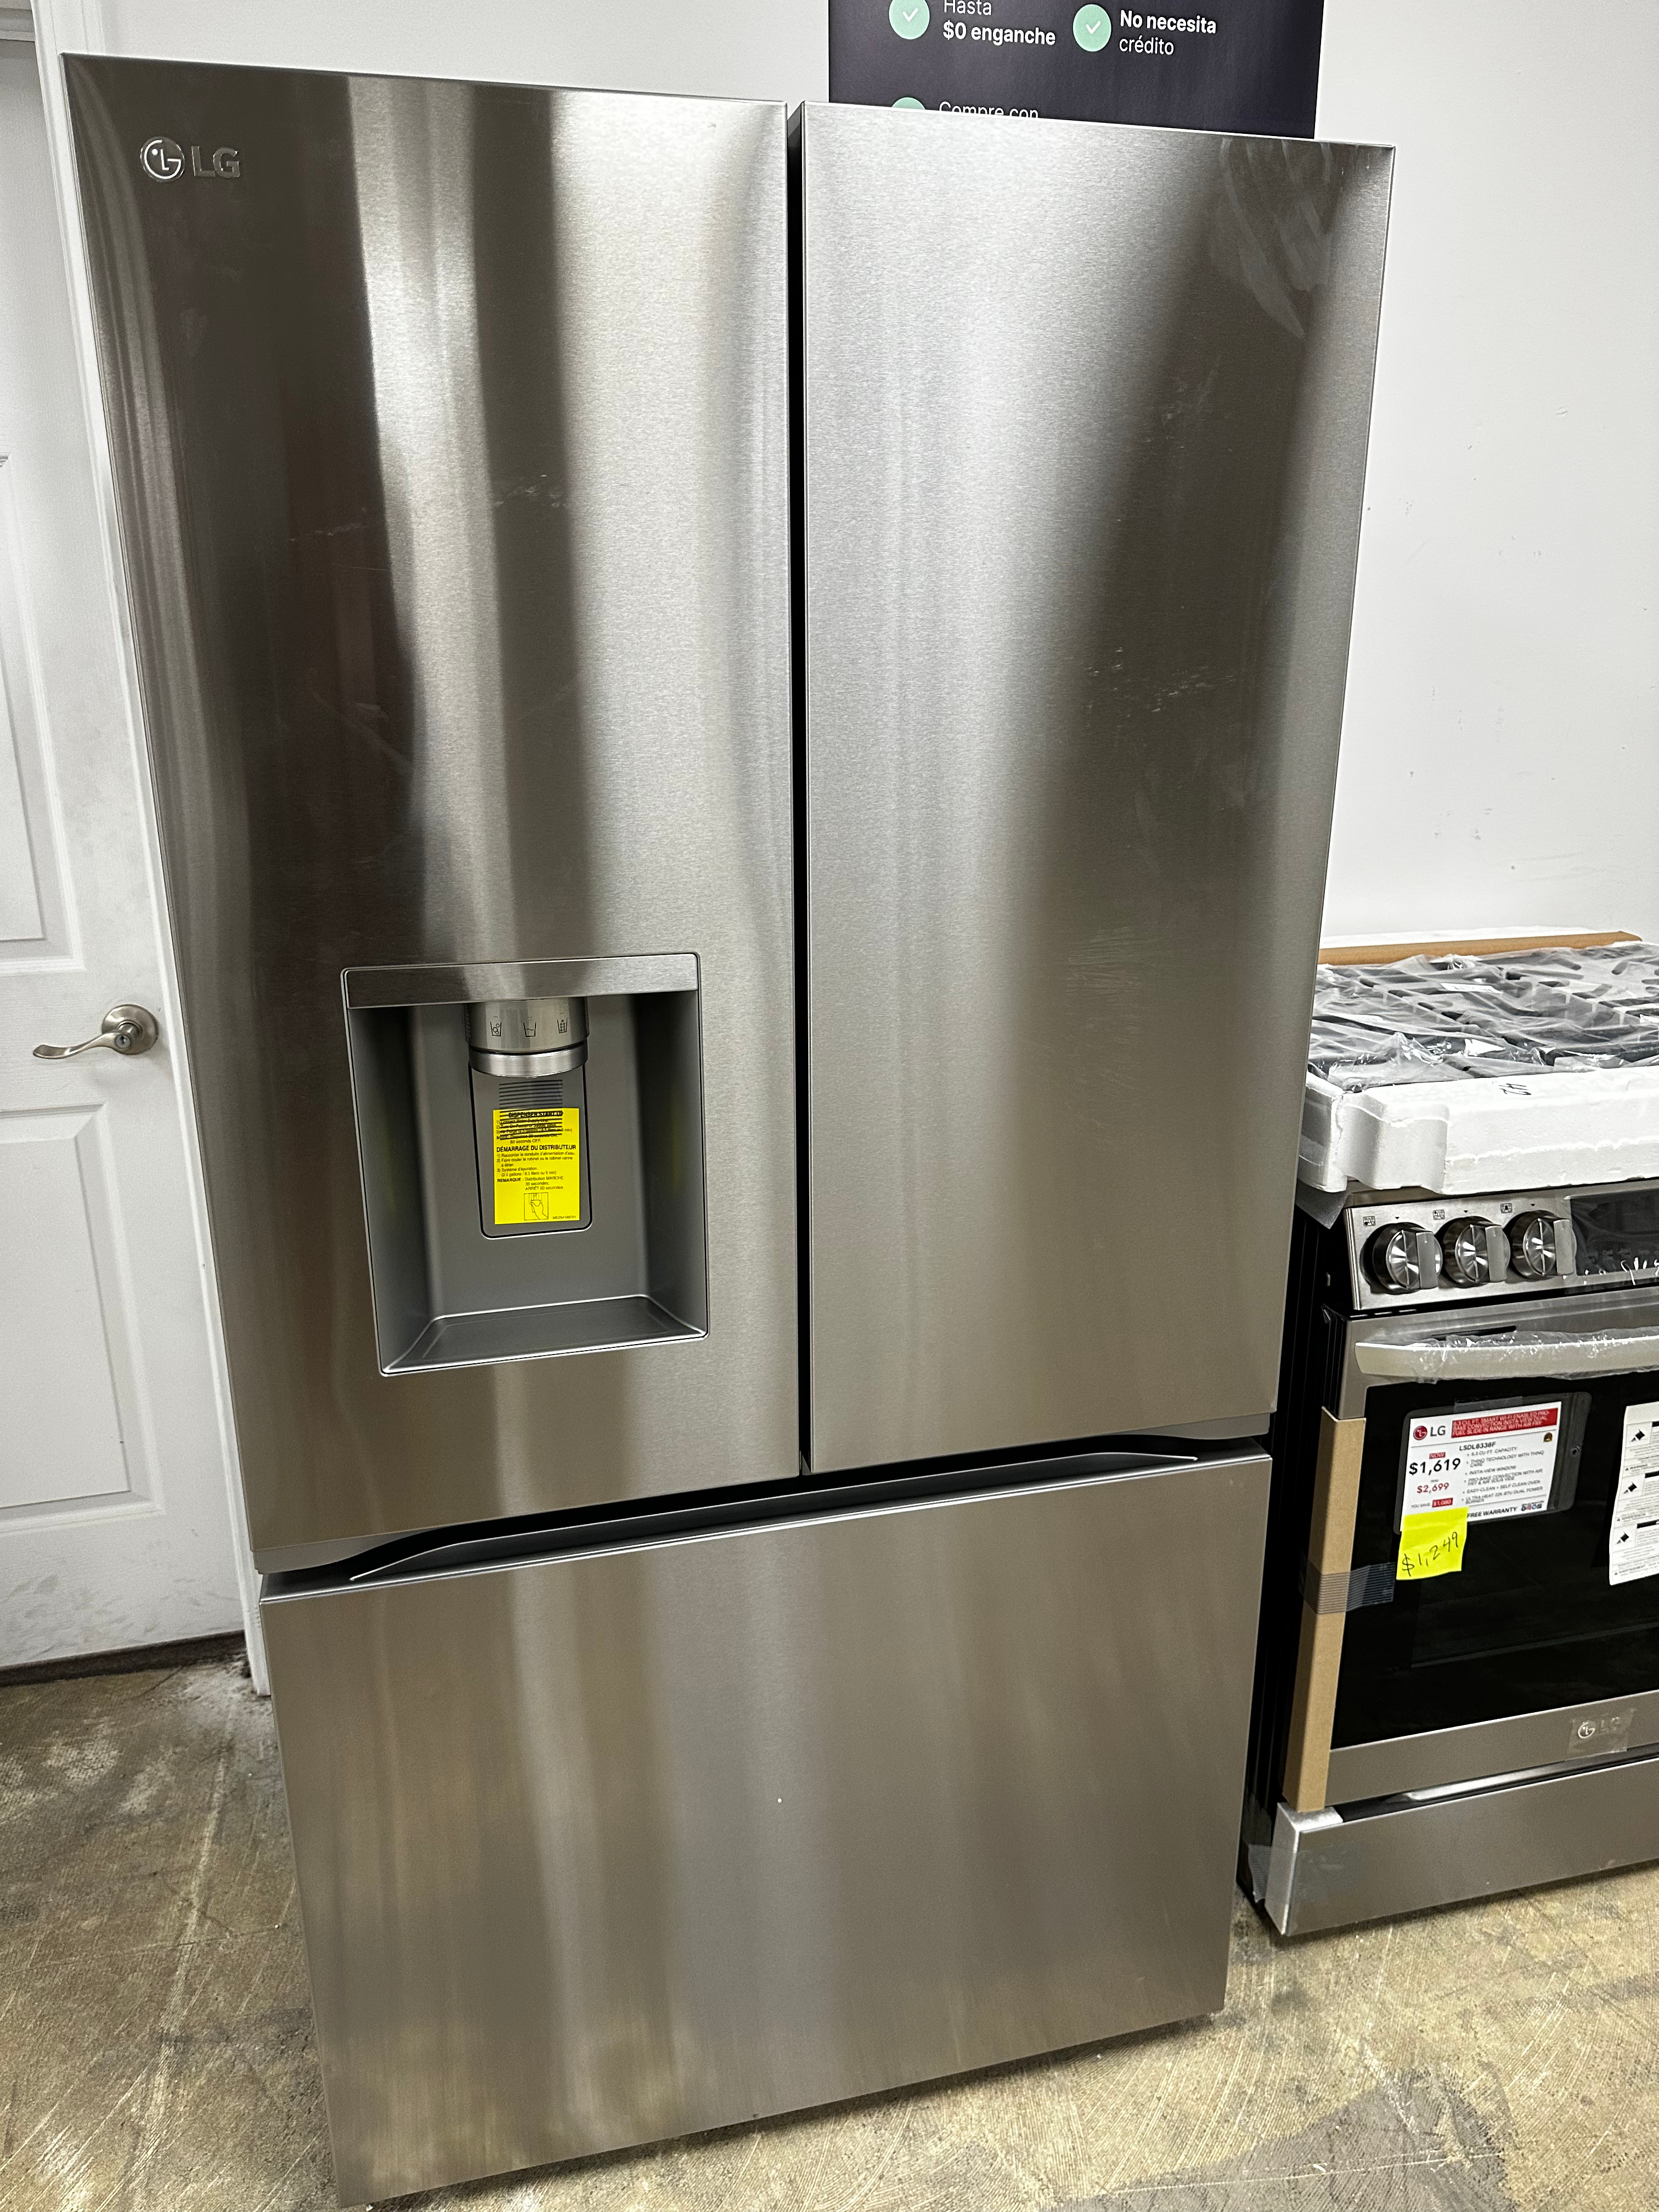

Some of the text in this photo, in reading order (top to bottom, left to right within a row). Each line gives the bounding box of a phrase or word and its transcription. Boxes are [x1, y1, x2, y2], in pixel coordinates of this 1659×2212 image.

[944, 0, 992, 15] Hasta
[1120, 9, 1216, 33] No necesita
[943, 20, 1056, 46] $0 enganche
[1119, 35, 1174, 55] crédito
[191, 145, 240, 178] LG
[1430, 1425, 1446, 1437] LG
[1409, 1458, 1461, 1476] $1,619
[1417, 1482, 1449, 1494] $2,699
[1483, 1506, 1517, 1515] WARRANTY
[1402, 1531, 1458, 1577] $1,249
